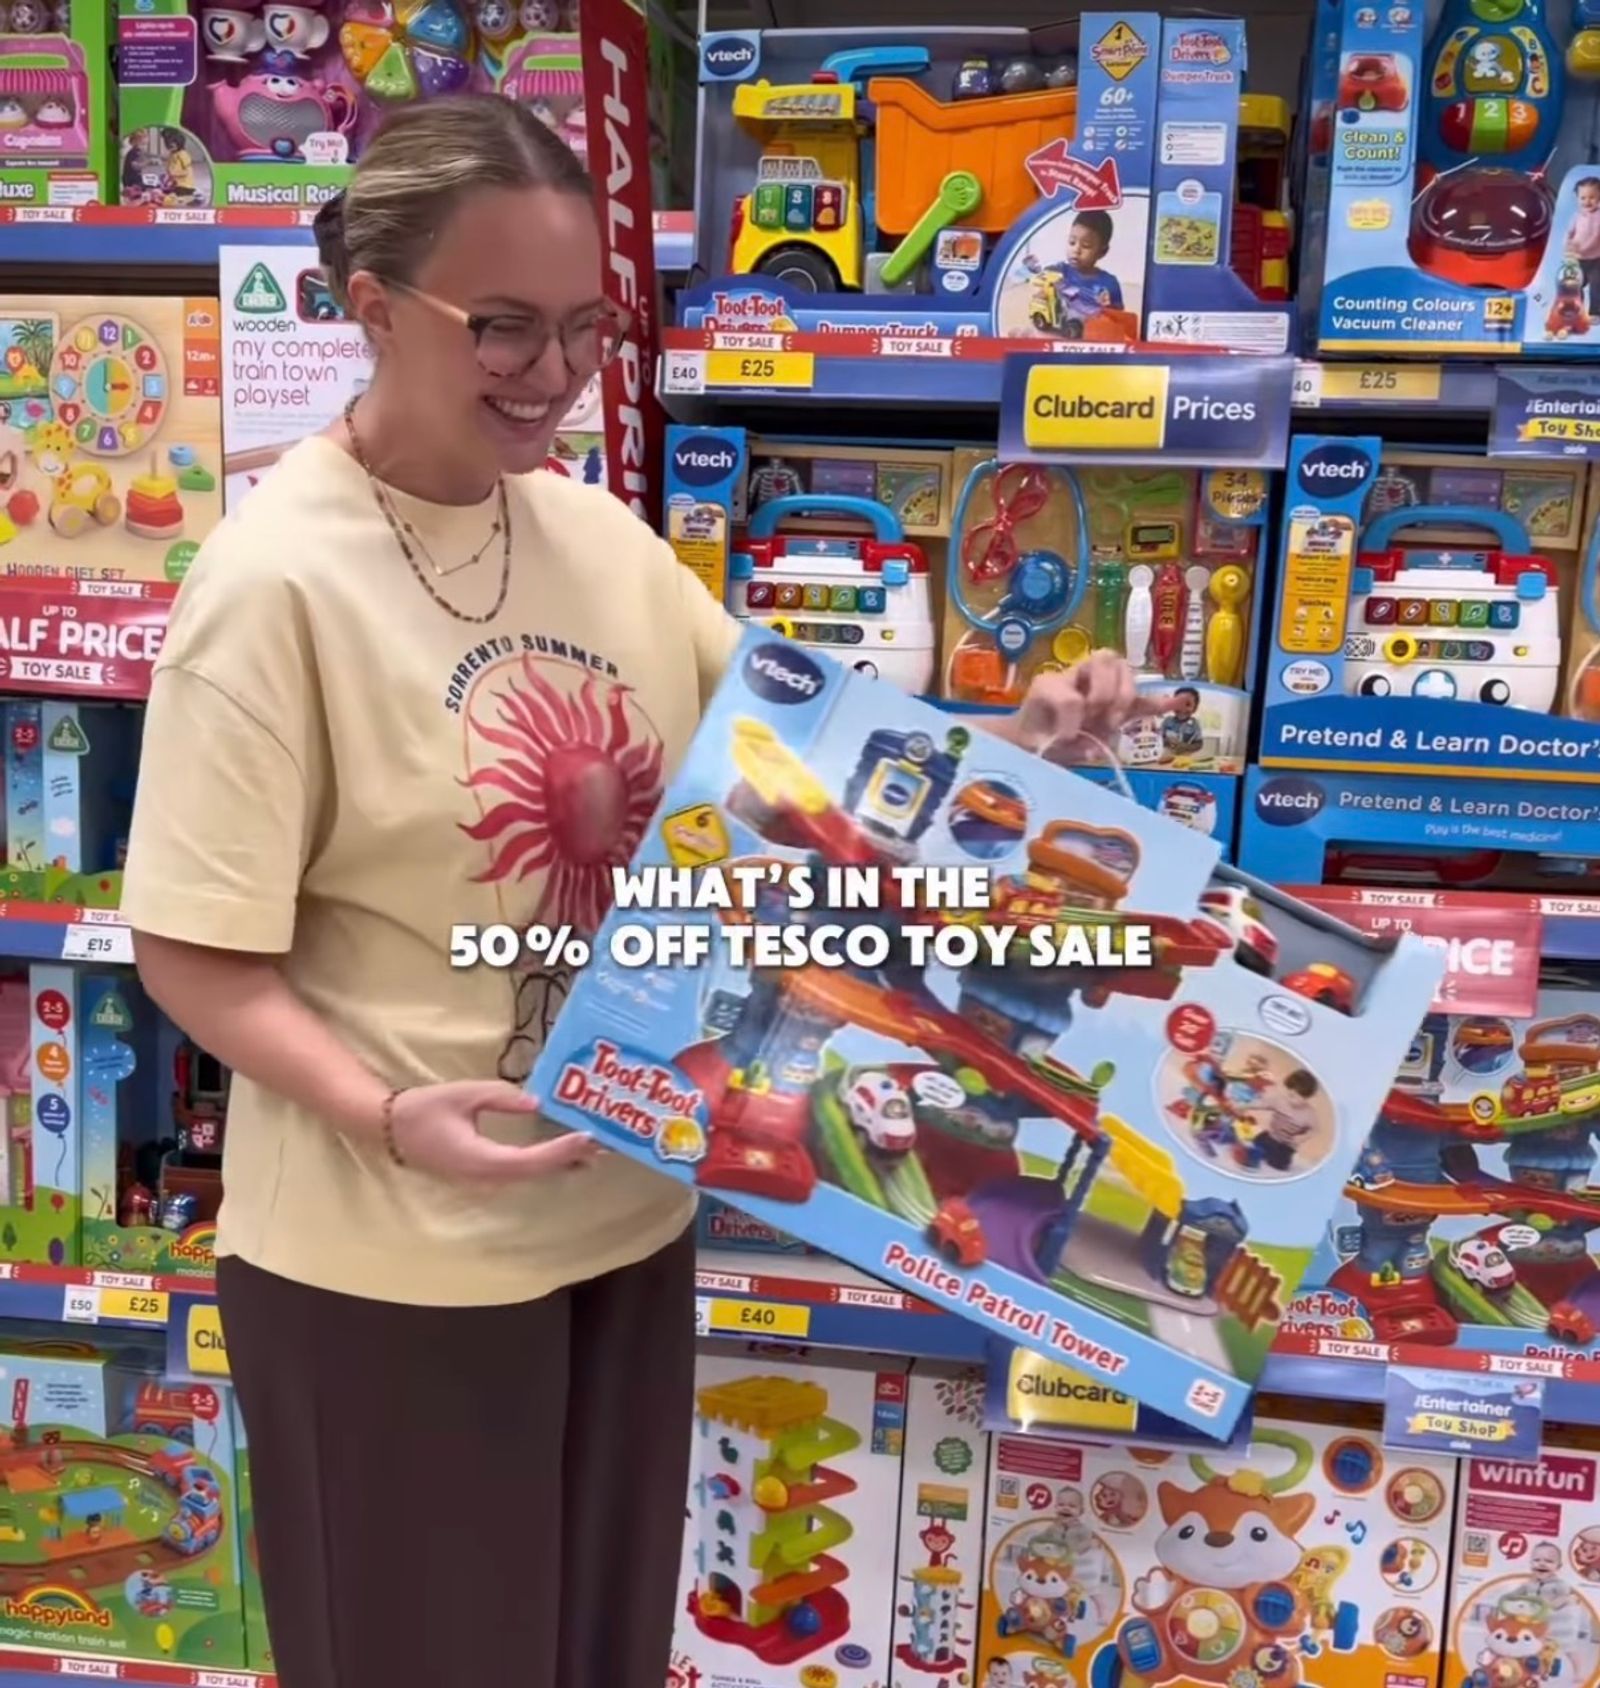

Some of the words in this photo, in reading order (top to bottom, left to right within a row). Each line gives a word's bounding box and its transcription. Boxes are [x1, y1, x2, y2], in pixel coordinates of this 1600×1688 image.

[707, 48, 753, 63] vtech
[1100, 87, 1134, 105] 60+
[1484, 102, 1499, 118] 2
[1514, 104, 1527, 119] 3
[601, 38, 637, 310] HALF
[228, 184, 299, 204] Musical
[22, 210, 40, 219] TOY
[43, 210, 66, 220] SALE
[163, 211, 183, 221] TOY
[185, 212, 208, 222] SALE
[715, 295, 784, 315] Toot-Toot
[1333, 296, 1409, 313] Counting
[1412, 297, 1476, 313] Colours
[1487, 301, 1512, 315] 12+
[233, 318, 297, 333] wooden
[1332, 316, 1396, 331] Vacuum
[1401, 317, 1464, 332] Cleaner
[102, 325, 118, 342] 12
[233, 338, 265, 362] my
[722, 336, 744, 347] TOY
[747, 337, 776, 348] SALE
[889, 341, 913, 352] TOY
[915, 342, 944, 353] SALE
[62, 354, 78, 367] 10
[141, 352, 152, 366] 2
[233, 360, 278, 382] train
[282, 361, 339, 382] town
[672, 366, 698, 380] £40
[740, 359, 775, 378] £25
[1294, 379, 1313, 393] 40
[1359, 371, 1397, 389] £25
[233, 386, 311, 409] playset
[145, 407, 155, 421] 4
[1033, 394, 1155, 420] Clubcard
[1172, 396, 1256, 421] Prices
[81, 425, 91, 439] 7
[1538, 420, 1567, 436] Toy
[1573, 423, 1600, 438] Sho
[103, 432, 113, 446] 6
[675, 451, 734, 469] vtech
[1301, 461, 1366, 479] vtech
[1224, 471, 1248, 488] 34
[87, 584, 107, 595] TOY
[110, 586, 134, 596] SALE
[42, 605, 59, 617] UP
[62, 606, 78, 618] TO
[58, 620, 164, 661] PRICE
[22, 661, 52, 678] TOY
[55, 664, 92, 680] SALE
[445, 635, 515, 714] SORRENTO
[520, 633, 619, 678] SUMMER
[750, 654, 819, 696] vtech
[1280, 723, 1383, 749] Pretend
[1389, 729, 1408, 750] &
[1416, 731, 1490, 753] Learn
[1498, 734, 1600, 759] Doctor'
[1258, 791, 1321, 809] vtech
[1338, 790, 1423, 812] Pretend
[1428, 796, 1444, 813] &
[1450, 796, 1511, 817] Learn
[1517, 801, 1600, 822] Doctor'
[1370, 893, 1395, 904] TOY
[1397, 895, 1426, 905] SALE
[1549, 900, 1576, 912] TOY
[1577, 902, 1600, 914] SAL
[90, 912, 109, 922] TOY
[1371, 916, 1391, 930] UP
[1394, 918, 1412, 931] TO
[87, 938, 113, 952] £15
[593, 1041, 701, 1117] Toot-Toot
[49, 1098, 59, 1111] 5
[557, 1065, 658, 1137] Drivers
[169, 1242, 216, 1266] happ
[100, 1274, 119, 1285] TOY
[122, 1276, 145, 1287] SALE
[719, 1277, 743, 1289] SALE
[70, 1298, 93, 1312] £50
[129, 1296, 159, 1314] £25
[847, 1291, 868, 1302] TOY
[871, 1293, 896, 1306] SALE
[740, 1307, 776, 1325] £40
[883, 1244, 963, 1298] Police
[966, 1282, 1046, 1339] Patrol
[1050, 1320, 1127, 1374] Tower
[1280, 1318, 1334, 1339] rivers
[1327, 1342, 1348, 1354] TOY
[1351, 1345, 1381, 1357] SALE
[1499, 1358, 1522, 1371] TOY
[1525, 1361, 1555, 1373] SALE
[1425, 1415, 1453, 1431] Toy
[1478, 1461, 1586, 1491] winfun
[6, 1597, 111, 1628] happyland
[33, 1629, 76, 1643] motion
[67, 1661, 86, 1671] TOY
[88, 1663, 111, 1674] SALE
[205, 1674, 226, 1685] TOY
[228, 1676, 250, 1688] SALE
